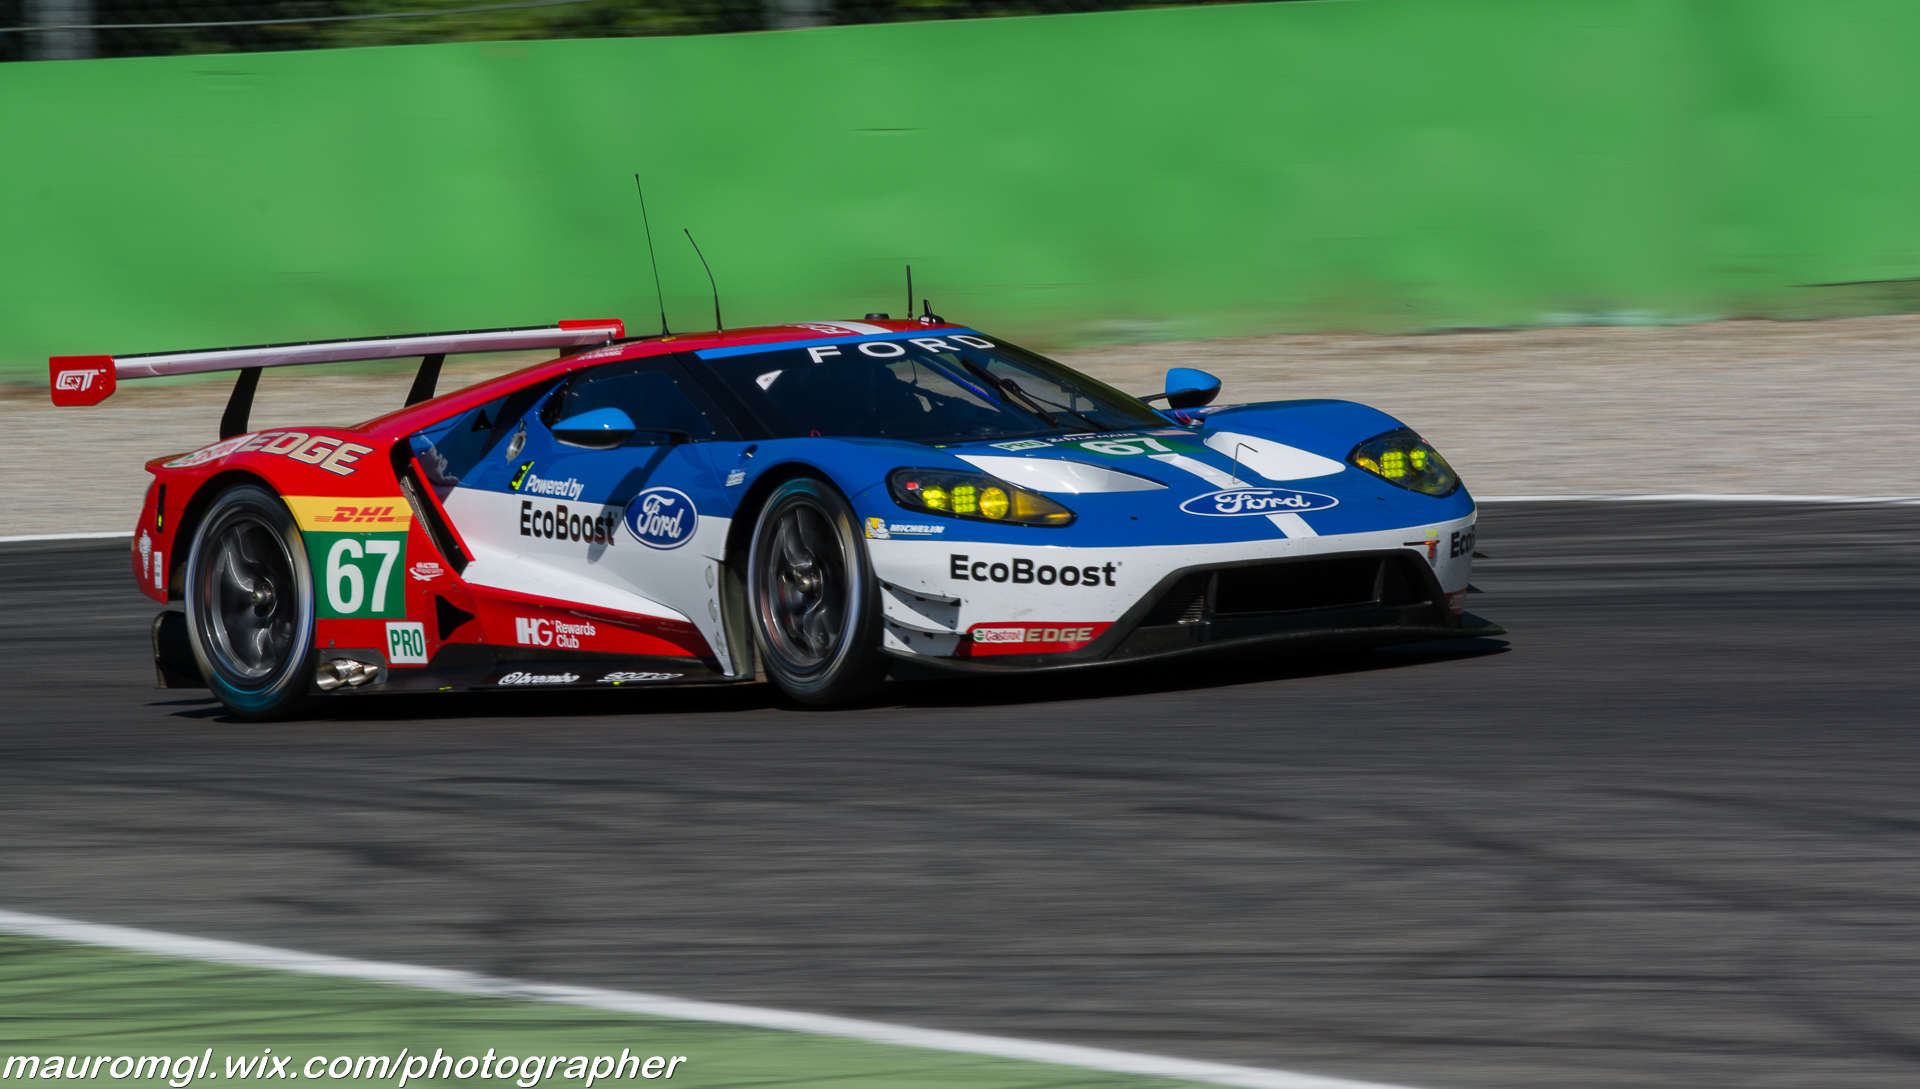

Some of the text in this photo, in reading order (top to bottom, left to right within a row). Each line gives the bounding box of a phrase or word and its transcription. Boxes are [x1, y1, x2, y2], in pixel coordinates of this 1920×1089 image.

[806, 334, 996, 363] FORD
[56, 368, 107, 391] GT
[234, 432, 377, 477] EDGE
[1080, 438, 1173, 455] 67
[524, 474, 585, 501] Powered by
[1214, 491, 1312, 513] Ford
[331, 506, 396, 523] DHL
[520, 500, 616, 546] EcoBoost
[636, 493, 685, 538] Ford
[889, 523, 946, 534] MICHELIN
[1424, 529, 1438, 538] TOW
[326, 538, 401, 614] 67
[950, 553, 1117, 587] EcoBoost
[515, 617, 553, 646] IHG
[555, 620, 596, 637] Rewards
[985, 627, 1095, 643] Castrol EDGE
[389, 629, 424, 657] PRO
[556, 635, 580, 649] Club
[518, 672, 580, 684] brembo
